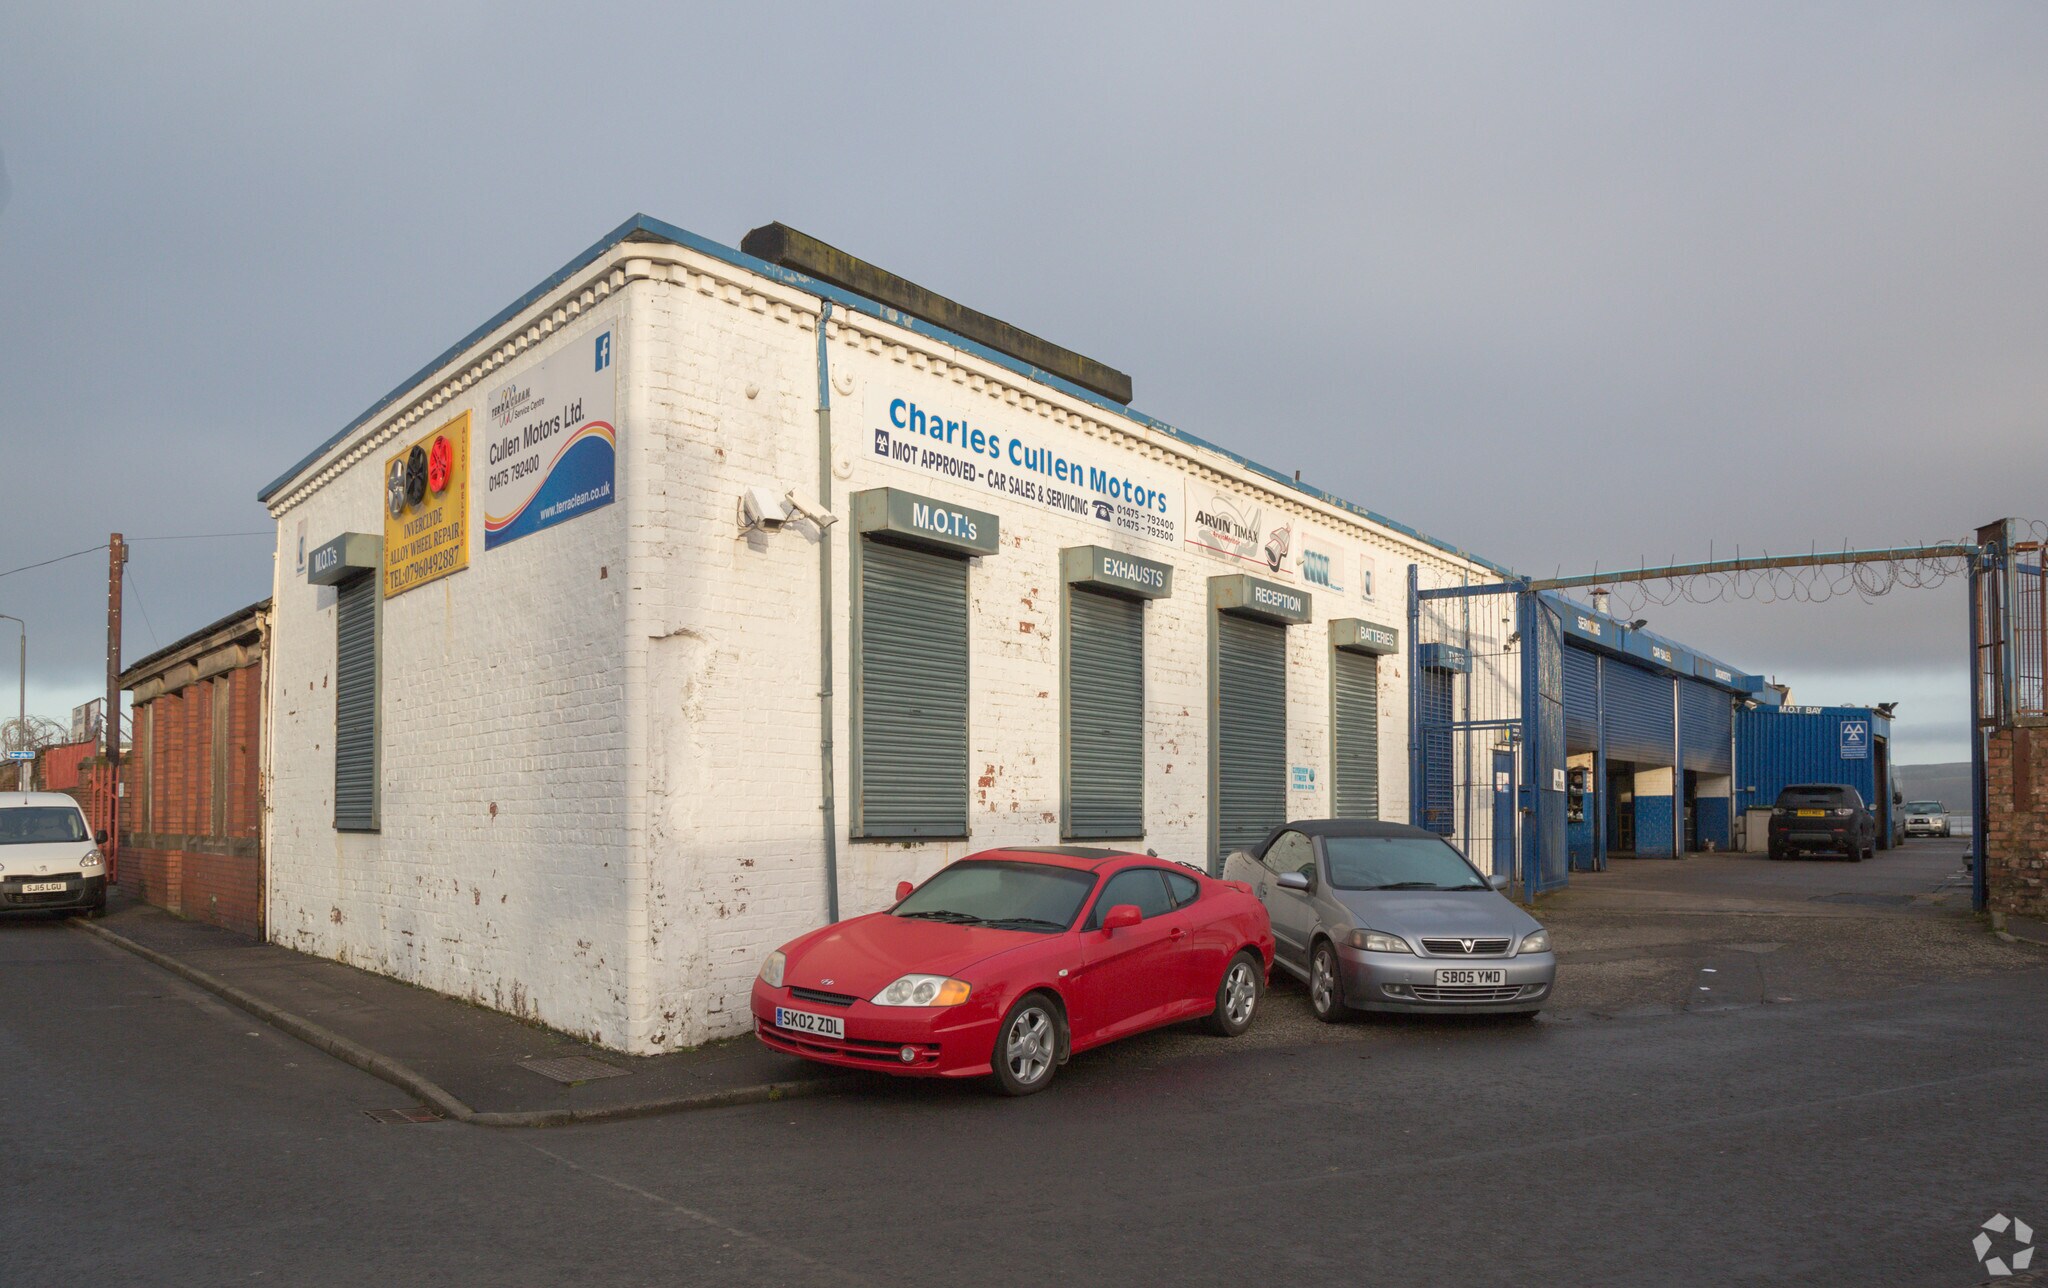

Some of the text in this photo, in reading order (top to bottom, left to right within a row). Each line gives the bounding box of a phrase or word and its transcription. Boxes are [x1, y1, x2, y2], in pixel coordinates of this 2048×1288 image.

[514, 397, 545, 419] Service Centre
[489, 397, 585, 465] Cullen Motors Ltd.
[890, 398, 1168, 513] Charles Cullen Motors
[488, 454, 539, 492] 01475 792400
[892, 440, 918, 465] MOT
[921, 448, 976, 482] APPROVED
[987, 469, 1007, 492] CAR
[1009, 476, 1037, 501] SALES
[1037, 485, 1044, 503] &
[1046, 488, 1089, 516] SERVICING
[540, 481, 611, 520] www.terraclean.co.uk
[403, 507, 443, 540] INVERCLYDE
[913, 503, 978, 541] M.O.T.'s
[1117, 505, 1139, 520] 01475
[1147, 514, 1174, 530] 792400
[1117, 517, 1139, 531] 01475
[1147, 526, 1174, 542] 792500
[1195, 510, 1259, 543] ARVIN TIMAX
[390, 521, 460, 566] ALLOY WHEEL REPAIR
[1103, 557, 1164, 588] EXHAUSTS
[1255, 586, 1301, 612] RECEPTION
[1360, 626, 1395, 647] BATTERIES
[26, 883, 62, 892] SJ15 LGU
[1442, 971, 1500, 983] SB05 YMD
[783, 1011, 841, 1035] SK02 ZDL
